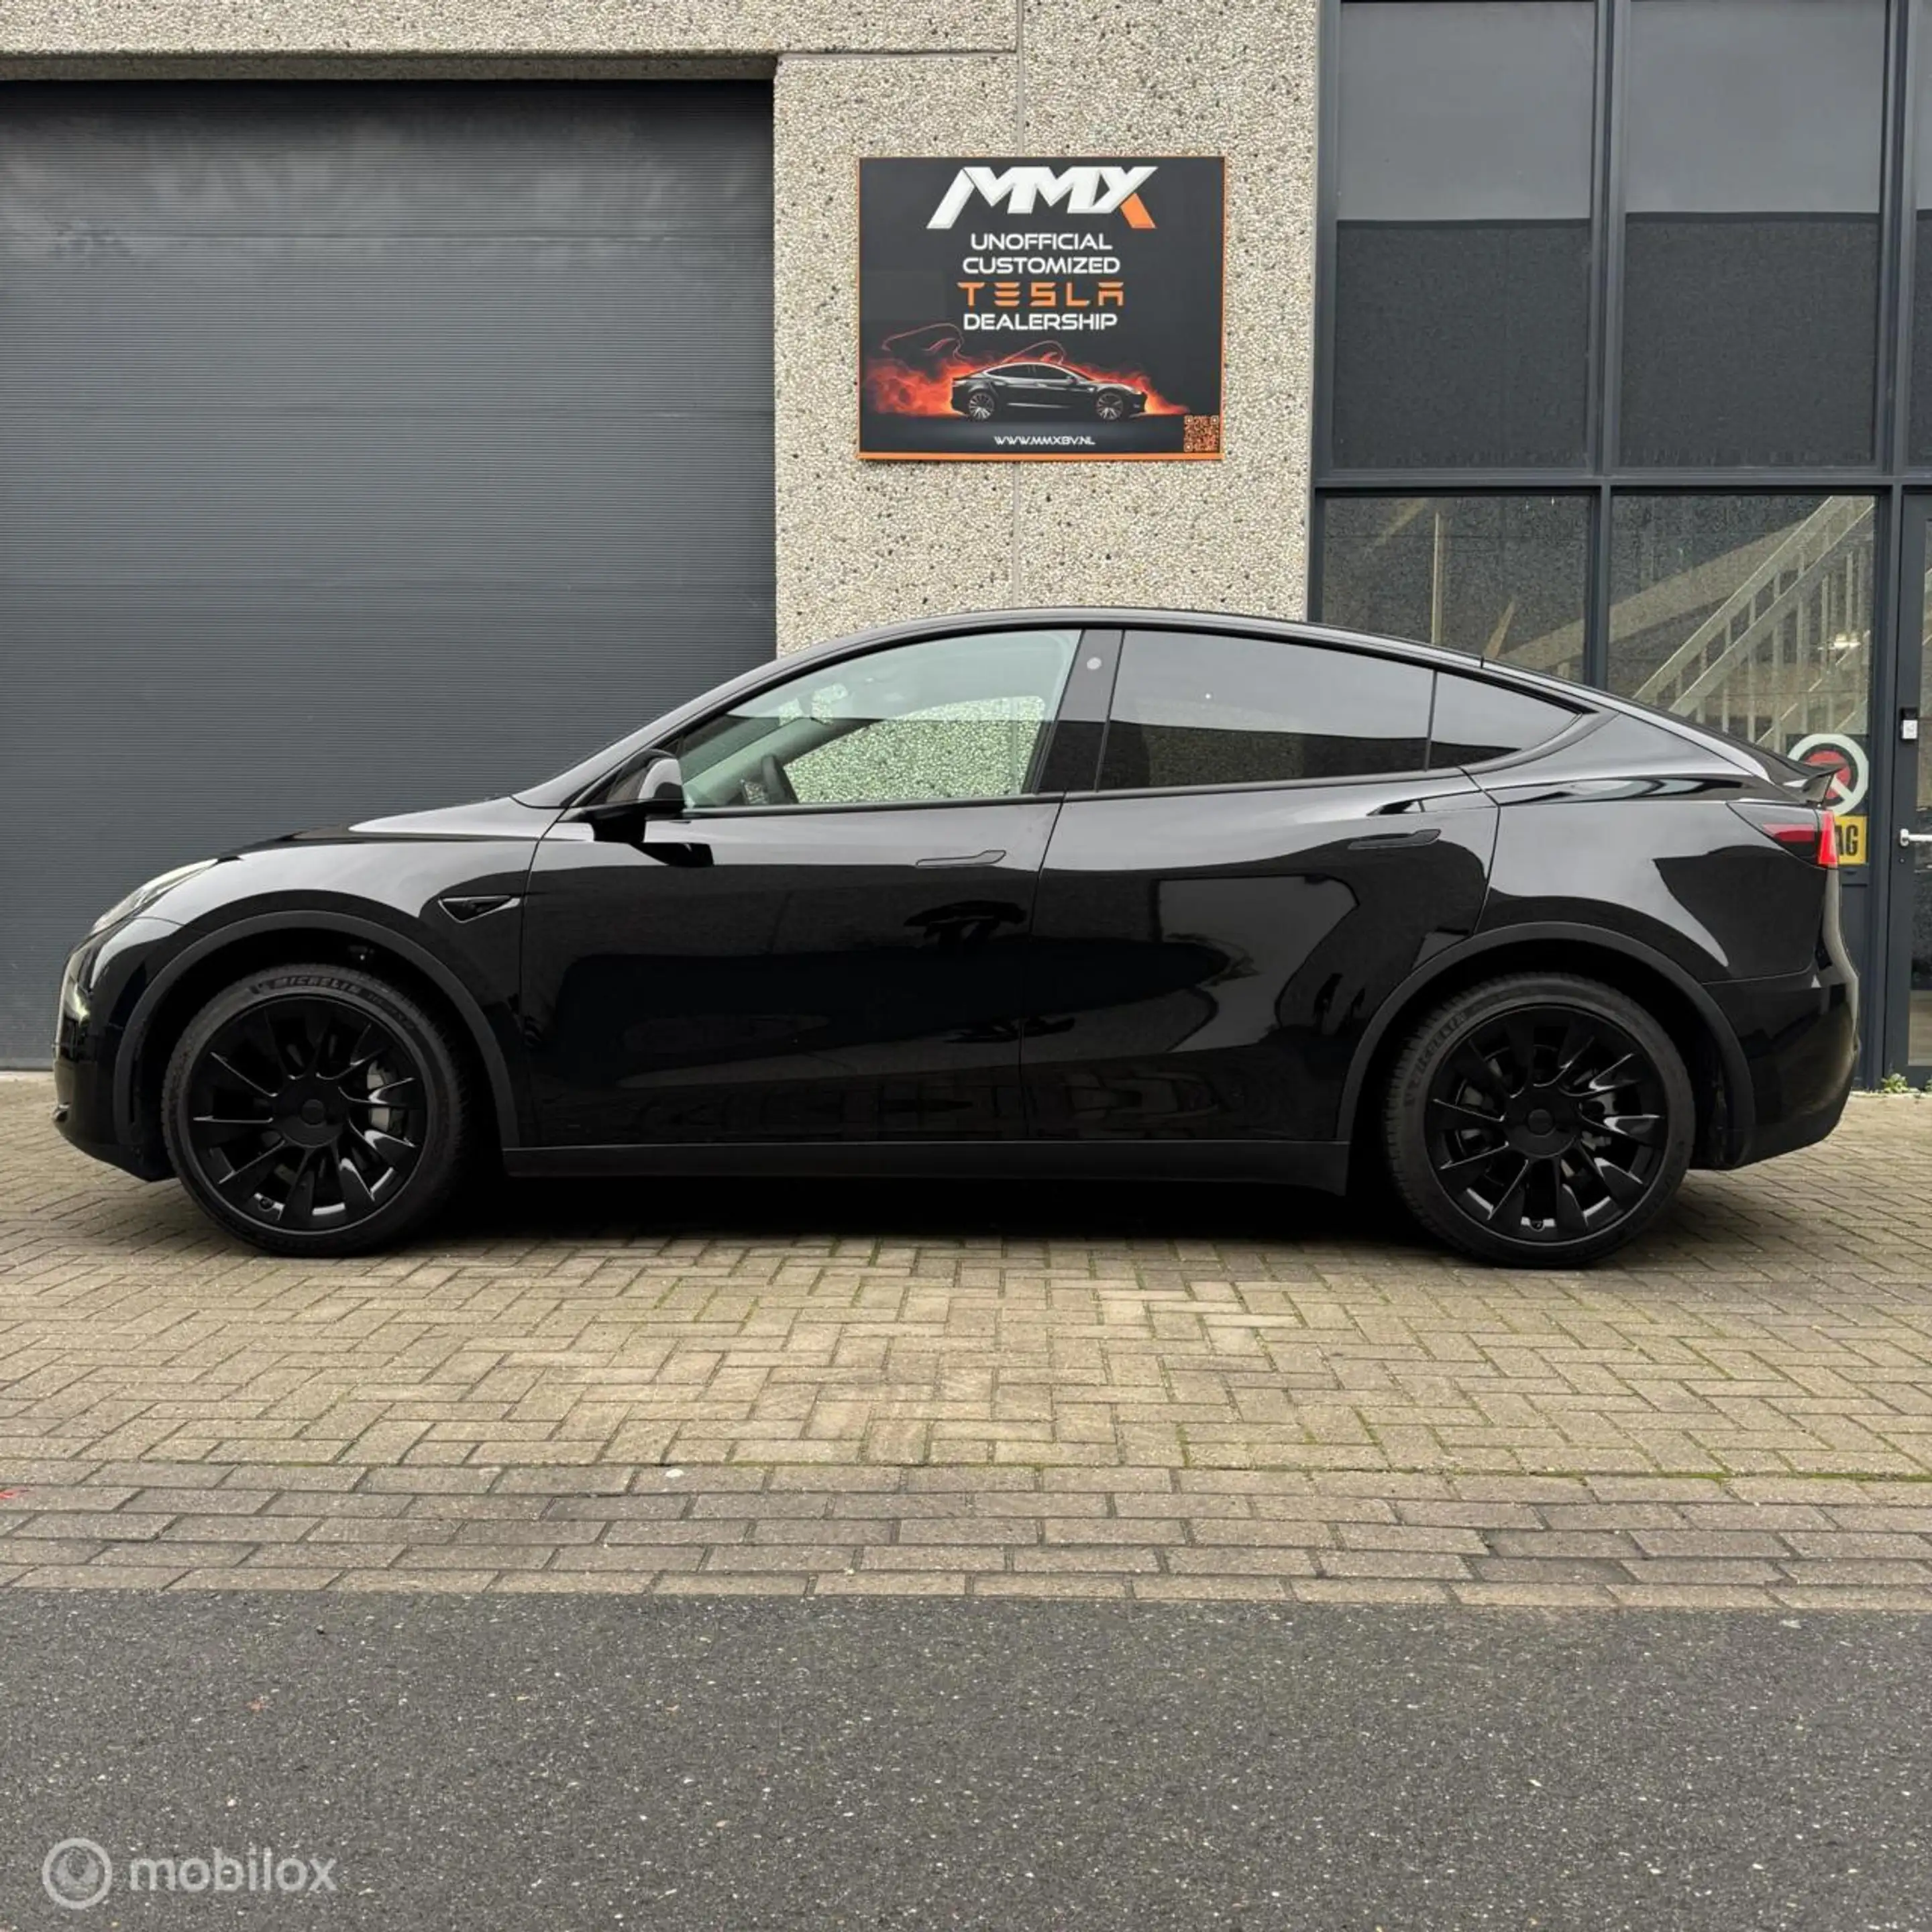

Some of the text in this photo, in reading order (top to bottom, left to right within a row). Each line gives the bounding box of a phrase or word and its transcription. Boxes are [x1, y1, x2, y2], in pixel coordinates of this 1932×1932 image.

[926, 166, 1158, 229] MMX
[970, 233, 1113, 250] UNOFFICIAL
[962, 256, 1120, 274] CUSTOMIZED
[957, 282, 1124, 307] TESLA
[963, 313, 1117, 331] DEALERSHIP
[994, 435, 1096, 445] WWW.MMXBV.NL
